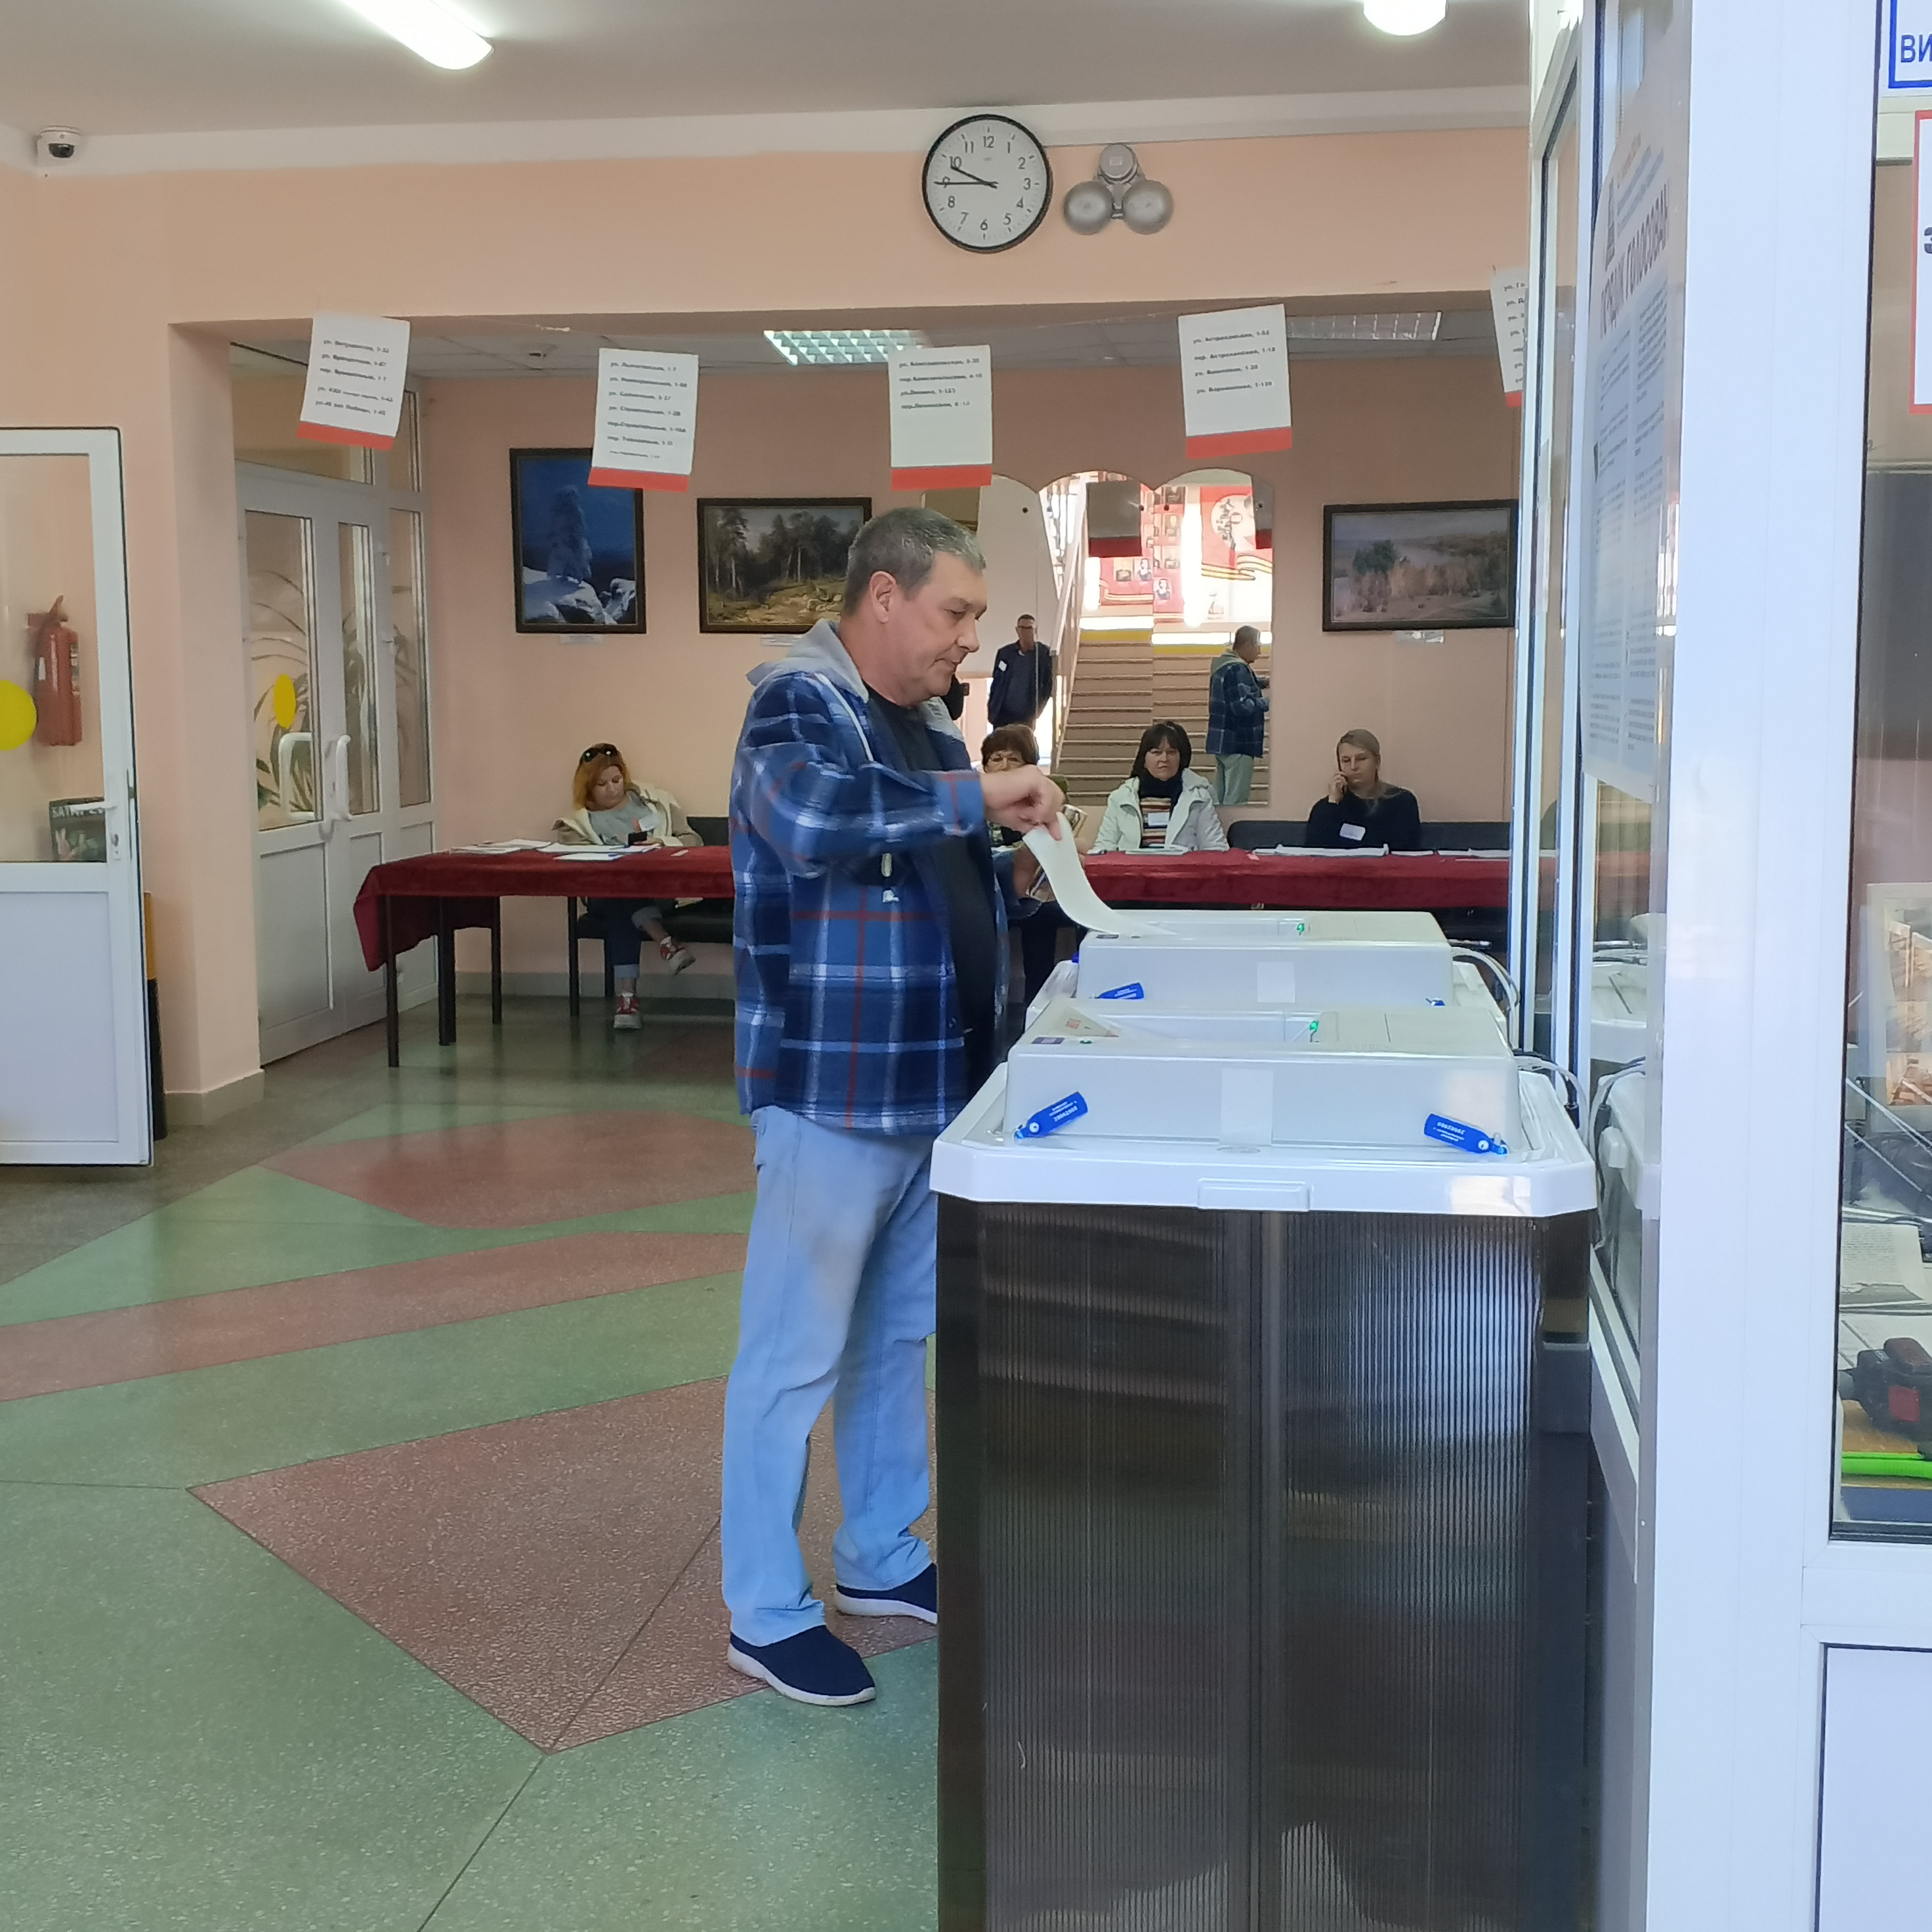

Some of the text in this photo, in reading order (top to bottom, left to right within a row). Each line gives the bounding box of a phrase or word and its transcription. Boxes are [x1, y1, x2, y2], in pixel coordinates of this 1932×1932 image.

[964, 141, 975, 154] 11
[984, 135, 994, 148] 12
[1007, 141, 1011, 154] 1
[950, 156, 962, 169] 10
[1018, 156, 1026, 169] 2
[942, 176, 951, 189] 9
[1023, 177, 1031, 190] 3
[948, 196, 956, 209] 8
[1016, 196, 1024, 209] 4
[960, 211, 969, 225] 7
[980, 218, 988, 231] 6
[1003, 213, 1012, 226] 5
